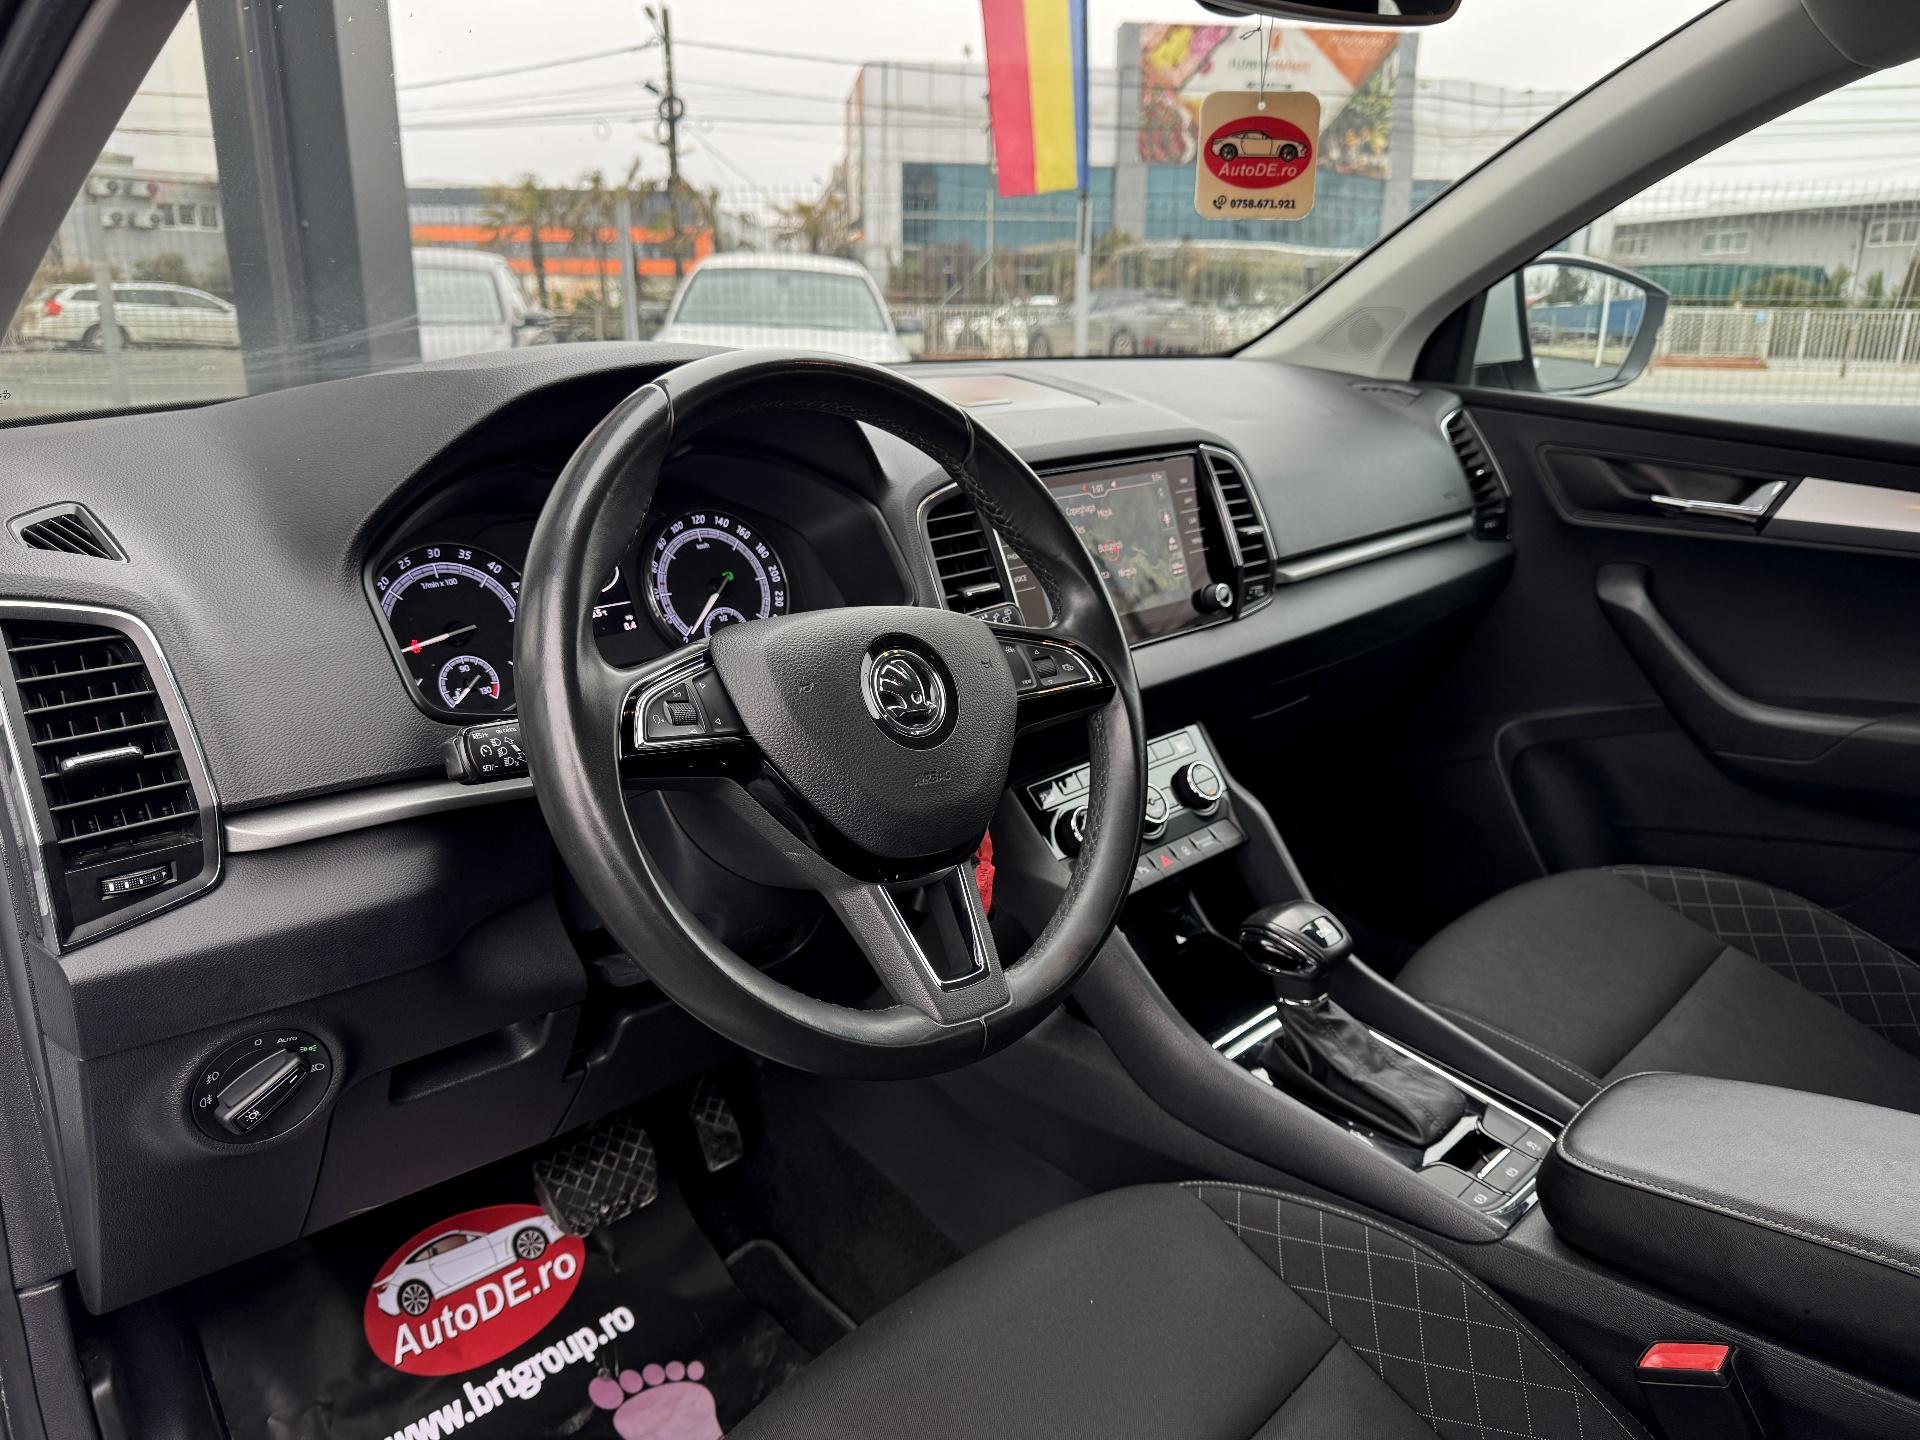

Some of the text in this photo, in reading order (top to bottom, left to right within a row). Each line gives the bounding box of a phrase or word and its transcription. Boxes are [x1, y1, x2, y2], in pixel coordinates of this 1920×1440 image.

[1218, 162, 1297, 178] AutoDE.ro
[1230, 198, 1296, 210] 0758.671.921
[691, 514, 706, 525] 120
[714, 516, 730, 528] 140
[669, 521, 684, 534] 100
[736, 525, 752, 540] 160
[426, 547, 441, 558] 30
[457, 549, 472, 560] 35
[755, 542, 770, 559] 180
[397, 557, 412, 570] 25
[486, 561, 502, 574] 40
[768, 564, 781, 583] 200
[377, 576, 390, 591] 20
[420, 580, 439, 590] 1/min
[445, 577, 458, 587] 100
[510, 581, 520, 593] 4
[774, 590, 784, 608] 230
[718, 614, 728, 622] 1/2
[459, 664, 470, 673] 90
[479, 686, 492, 695] 130
[392, 1252, 578, 1367] AutoDE.ro
